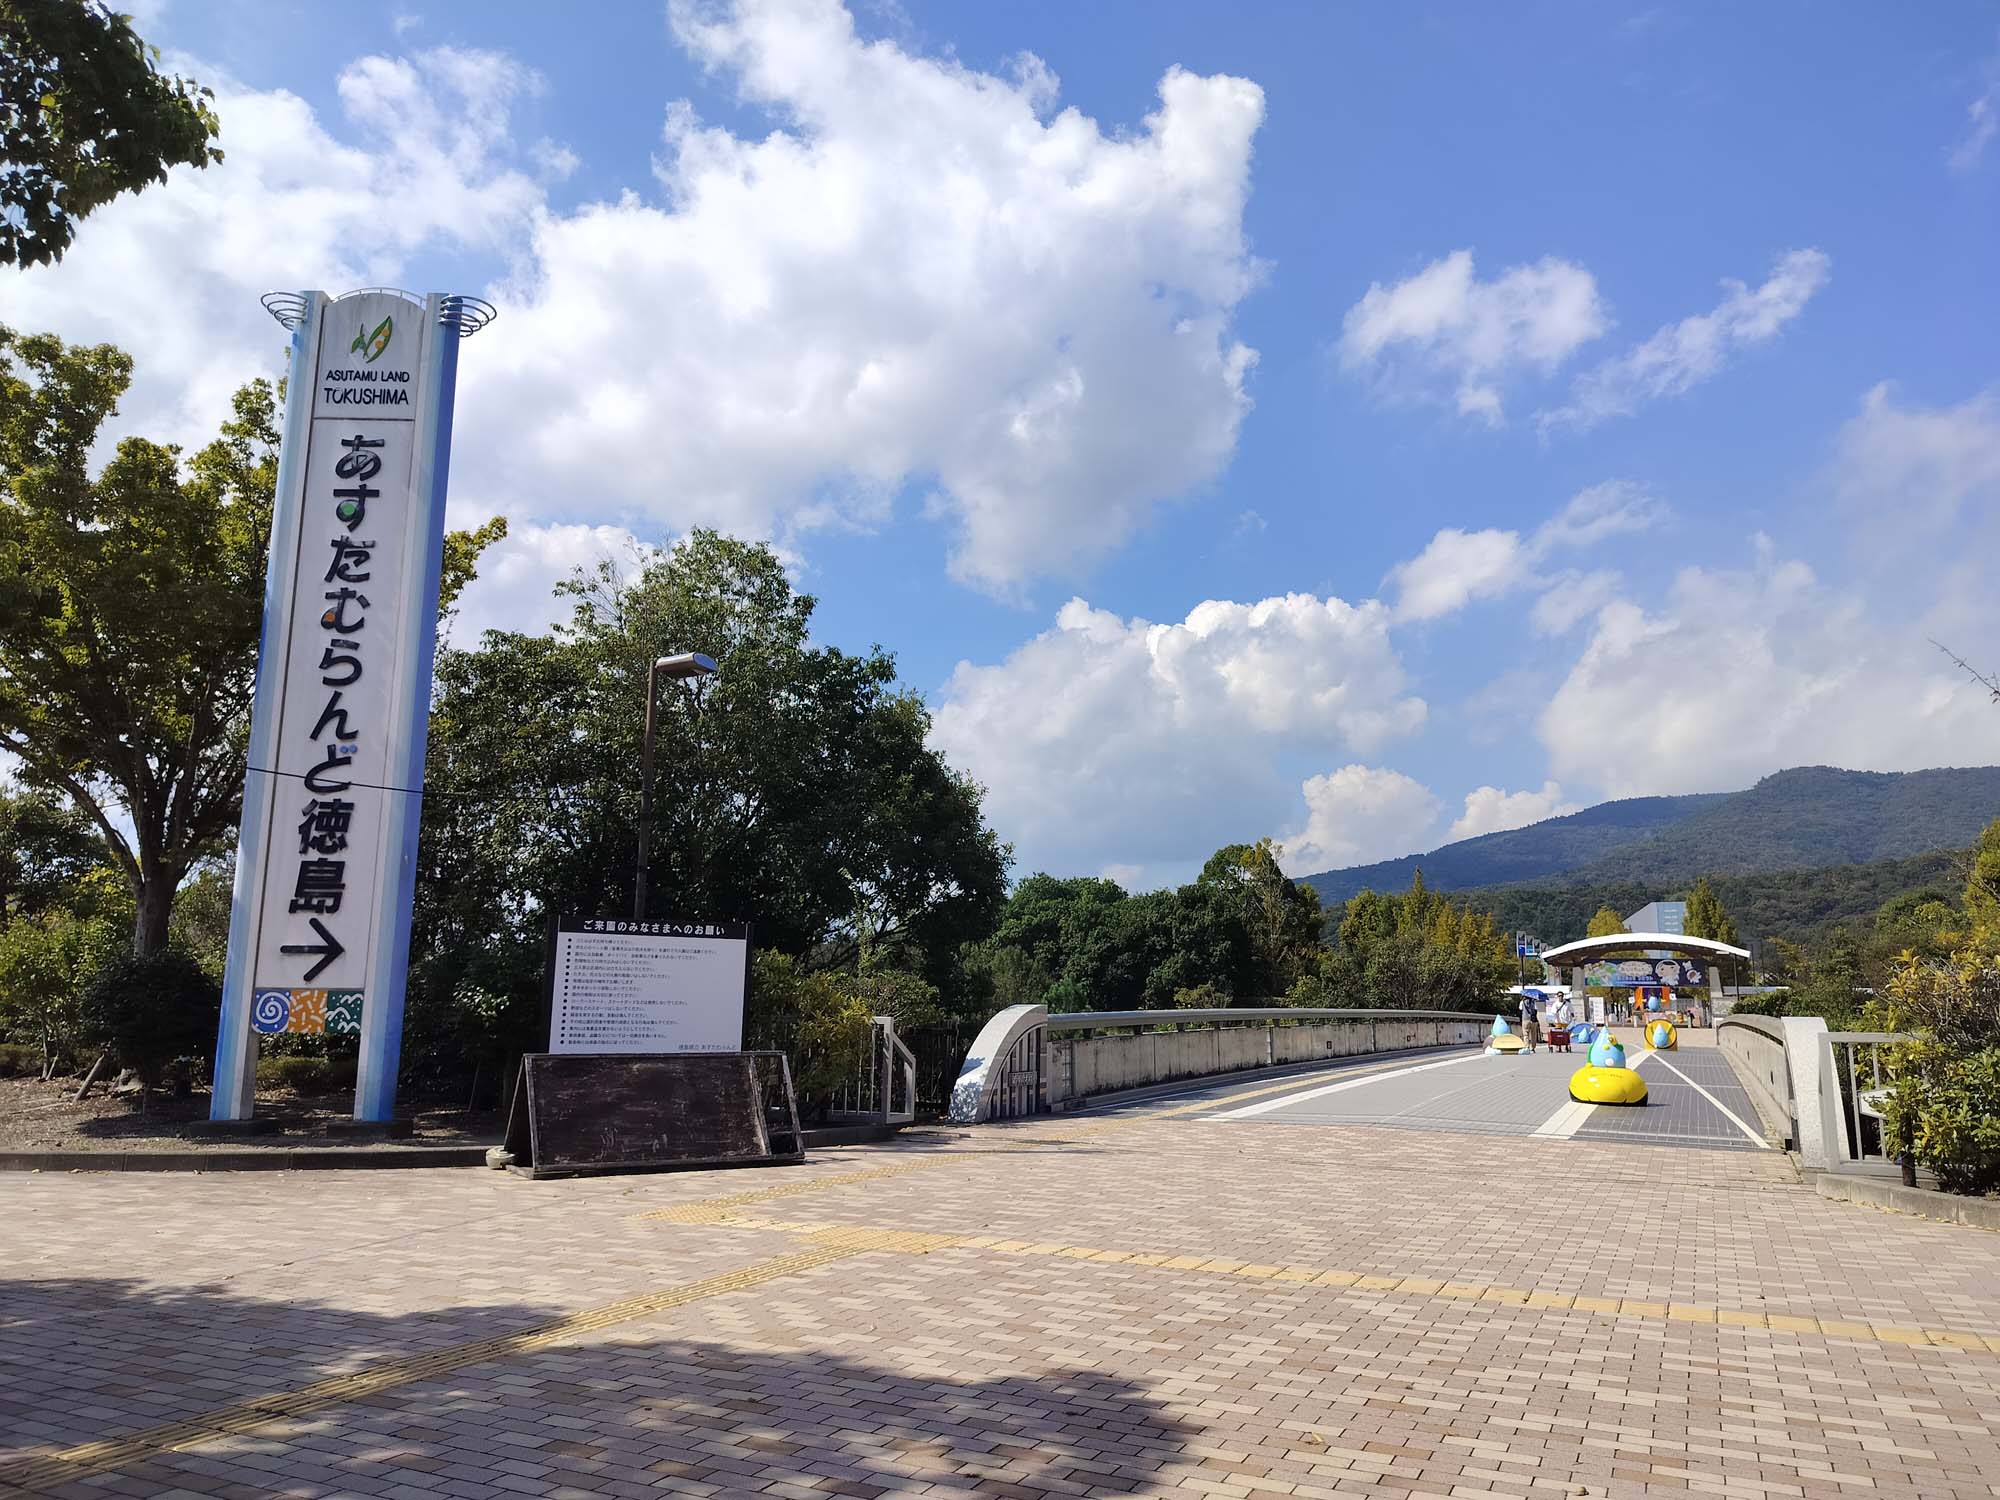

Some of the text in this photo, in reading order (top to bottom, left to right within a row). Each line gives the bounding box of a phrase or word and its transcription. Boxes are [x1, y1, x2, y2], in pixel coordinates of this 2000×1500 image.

[325, 369, 410, 383] ASUTAMU LAND
[324, 387, 409, 405] TOKUSHIMA
[288, 434, 385, 915] あすたむらんど徳島
[583, 919, 726, 936] ご来園のみなさまへのお願い
